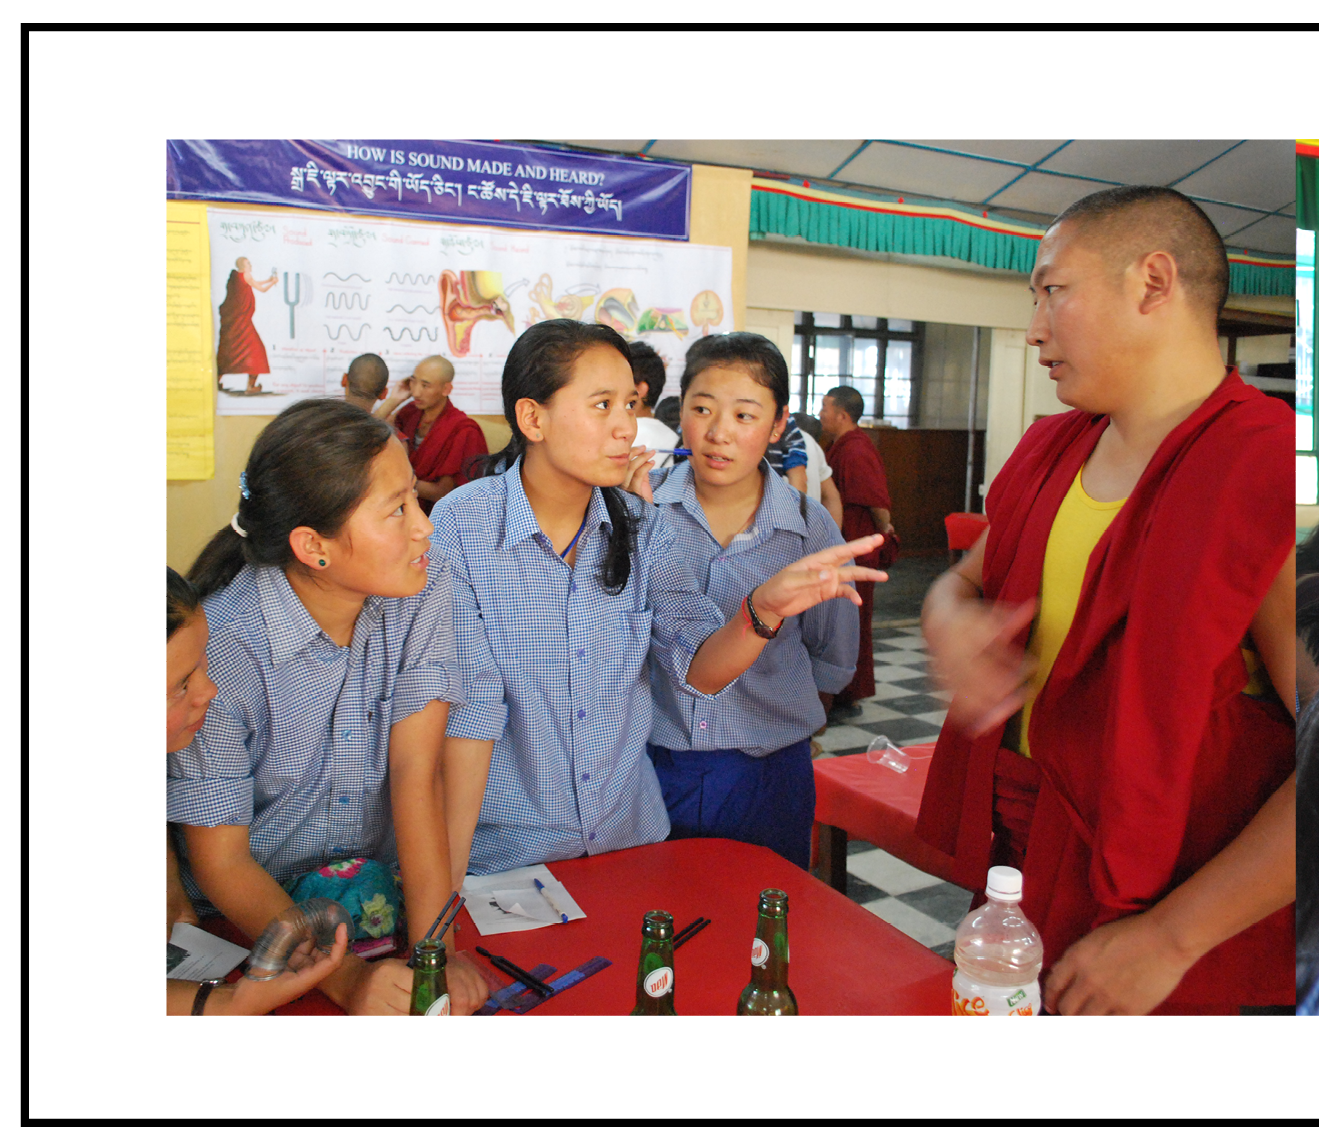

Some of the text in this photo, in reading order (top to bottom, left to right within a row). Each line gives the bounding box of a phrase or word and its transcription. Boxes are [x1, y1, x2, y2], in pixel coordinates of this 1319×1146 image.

[347, 145, 605, 187] HOW IS SOUND MADE AND HEARD?
